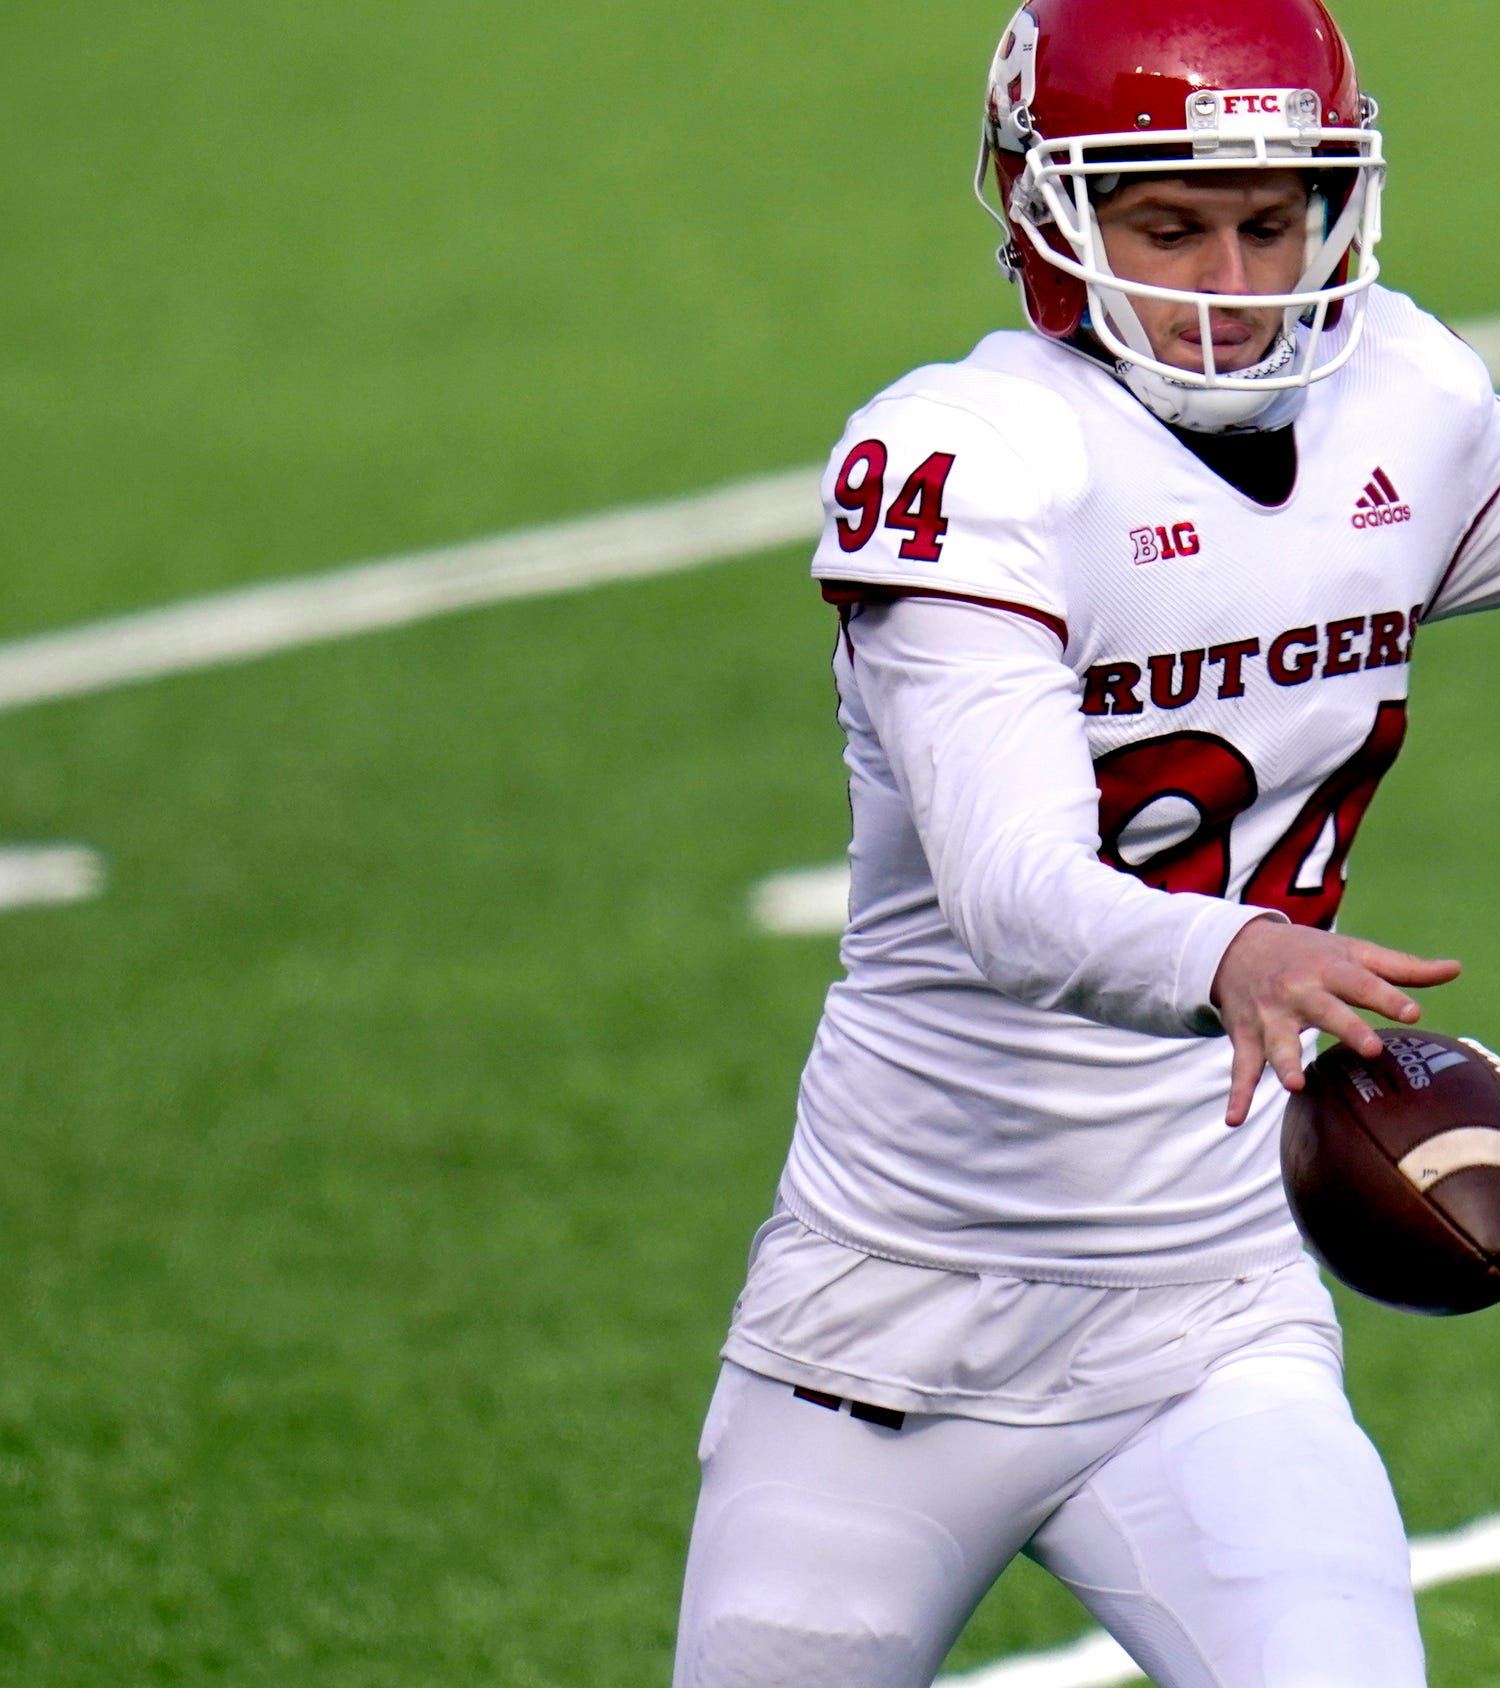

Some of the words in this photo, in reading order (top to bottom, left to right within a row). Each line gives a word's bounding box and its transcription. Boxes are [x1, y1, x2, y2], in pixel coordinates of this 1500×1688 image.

[834, 438, 956, 562] 94
[1352, 503, 1411, 529] adidas
[1093, 699, 1408, 932] 94
